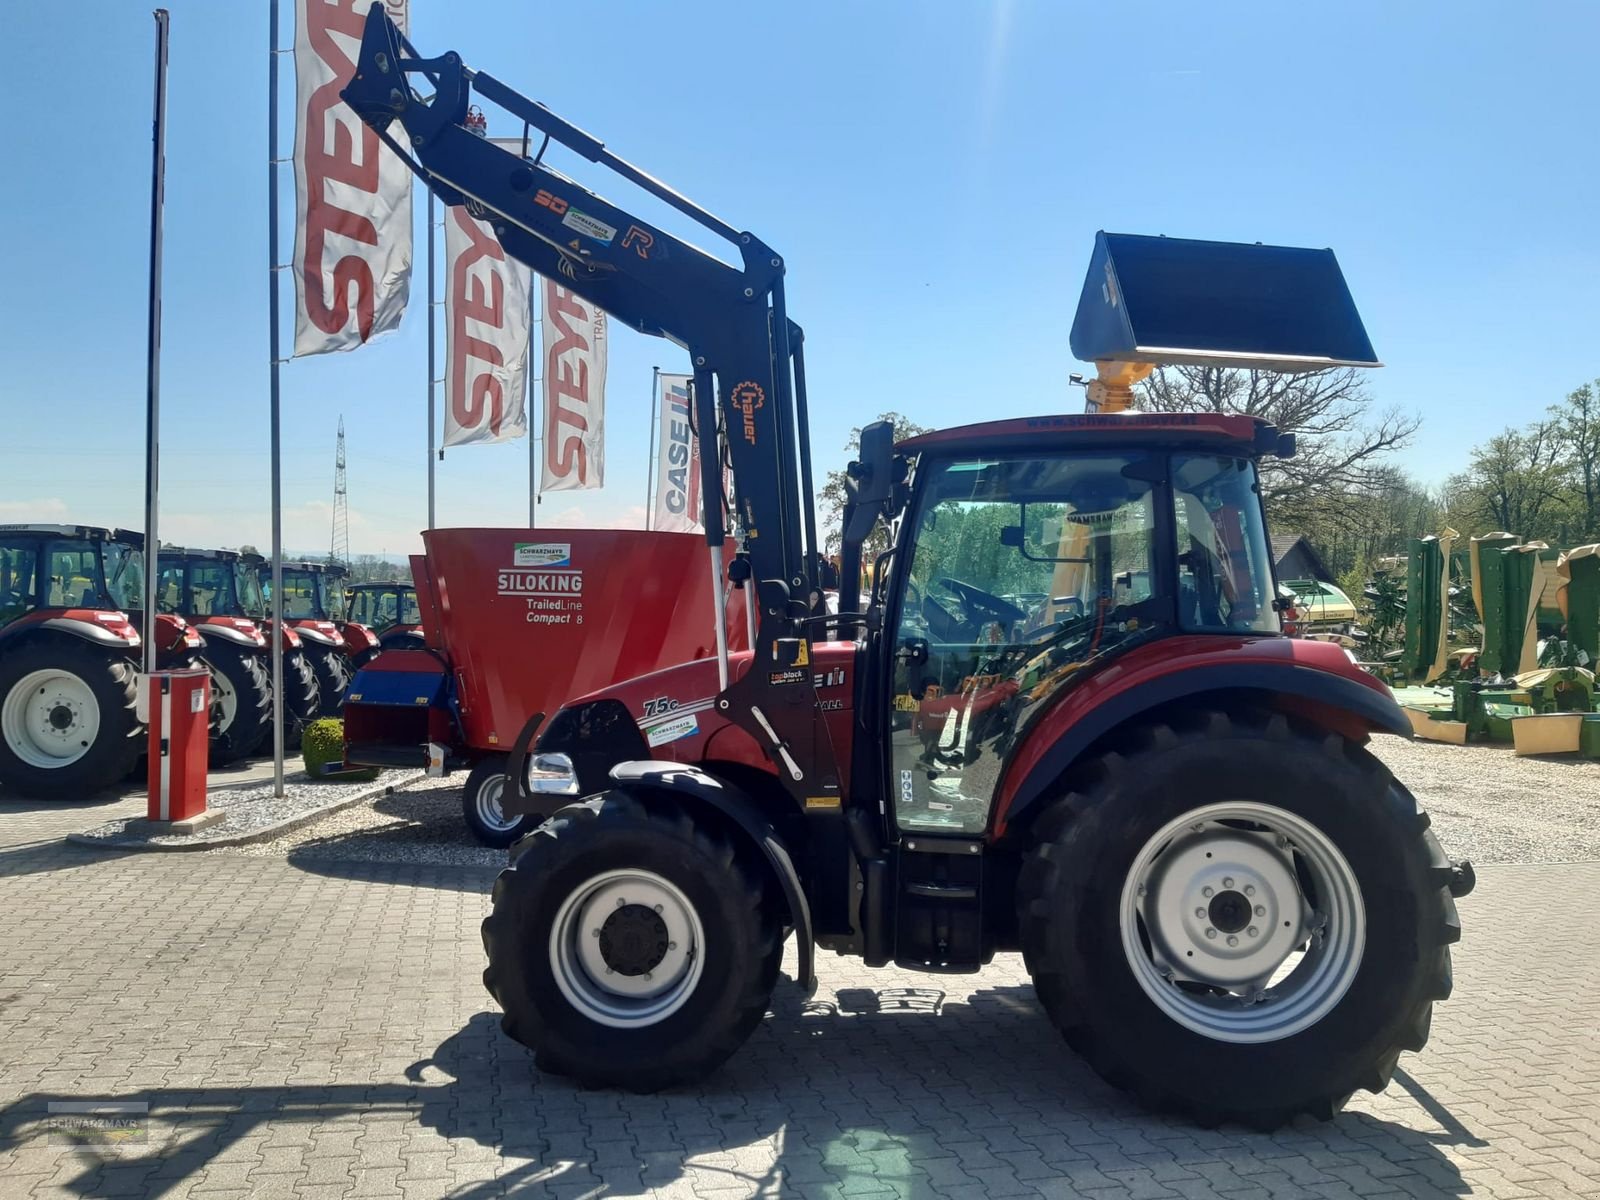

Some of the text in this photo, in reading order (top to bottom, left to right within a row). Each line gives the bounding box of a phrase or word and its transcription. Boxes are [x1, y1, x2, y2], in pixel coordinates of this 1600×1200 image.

[452, 205, 505, 437] STEY
[740, 390, 758, 446] hauer
[665, 419, 690, 515] CASE
[498, 574, 583, 592] SILOKING
[526, 612, 583, 625] Compact 8
[527, 598, 582, 611] TrailedLine
